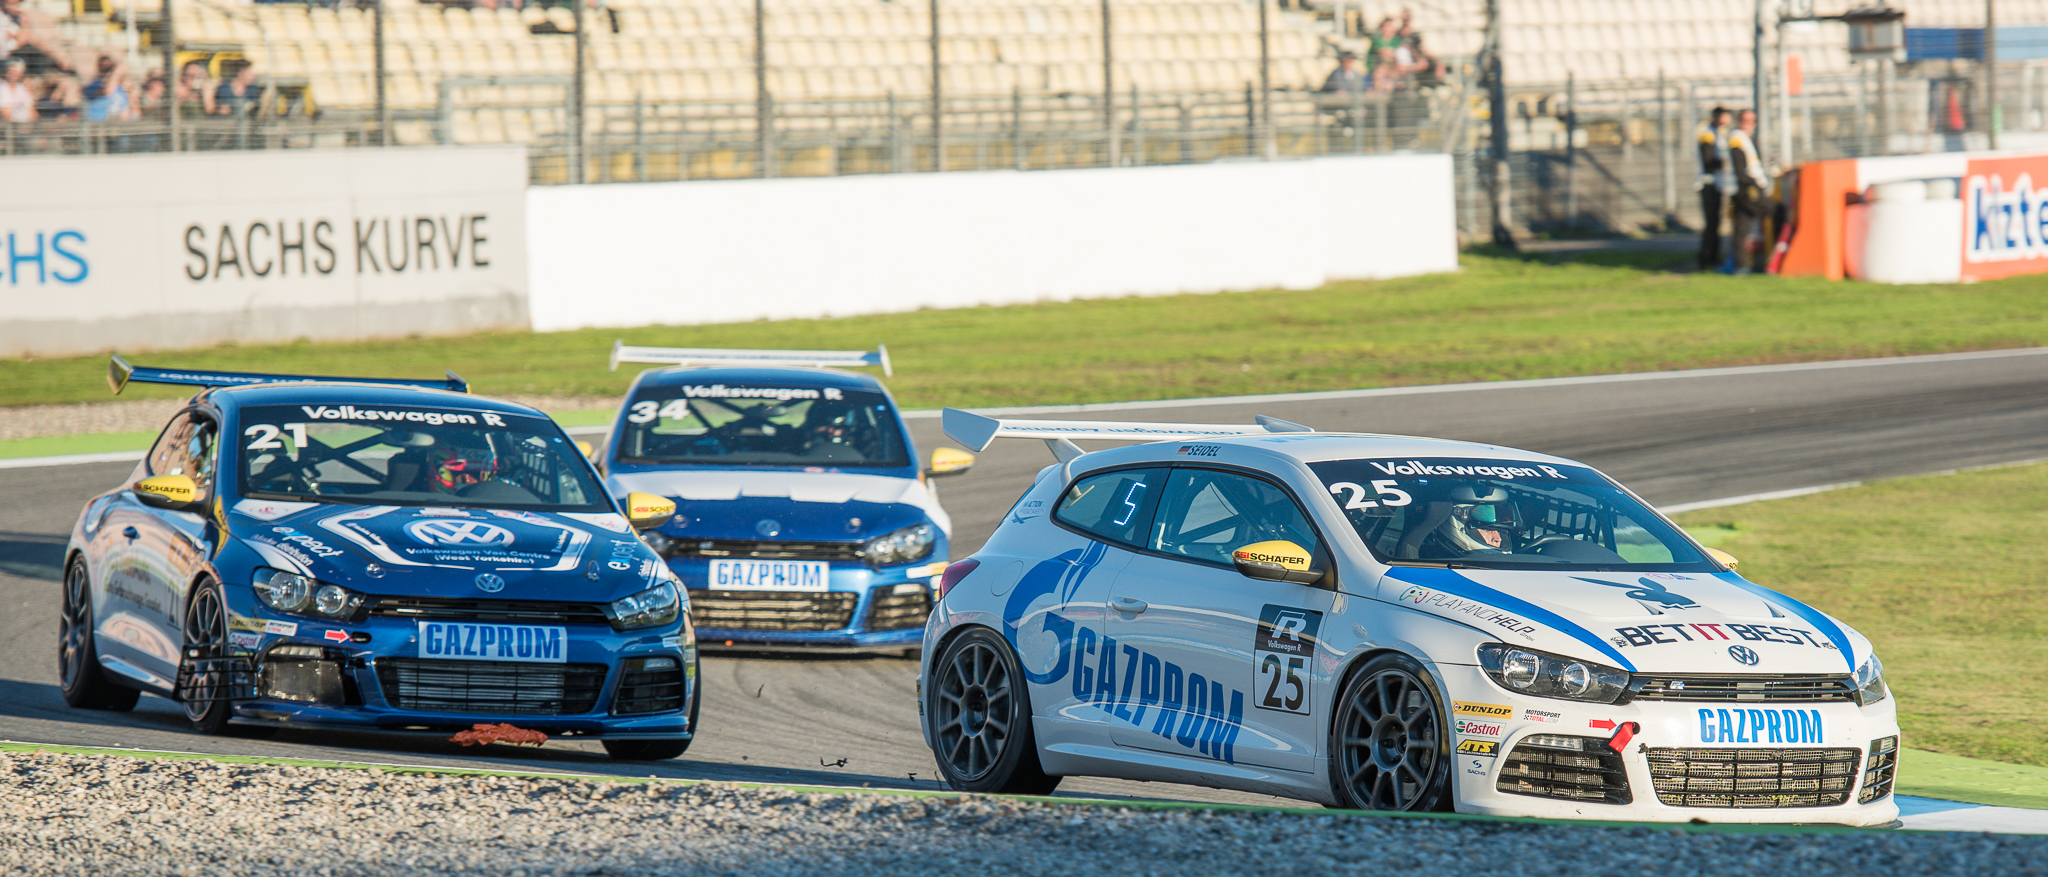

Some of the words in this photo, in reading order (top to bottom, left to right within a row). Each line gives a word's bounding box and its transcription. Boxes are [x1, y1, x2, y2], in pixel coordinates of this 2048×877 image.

[184, 220, 337, 281] SACHS
[354, 215, 492, 272] KURVE
[682, 384, 819, 401] Volkswagen
[823, 387, 844, 401] R
[301, 405, 477, 425] Volkswagen
[481, 413, 507, 427] R
[627, 399, 690, 423] 34
[244, 422, 308, 450] 21
[1187, 445, 1222, 457] SEIDEL
[1369, 460, 1541, 480] Volkswagen
[1538, 464, 1568, 480] R
[1329, 479, 1413, 510] 25
[405, 547, 481, 556] Volkswagen
[716, 562, 821, 588] GAZPROM
[425, 623, 561, 660] GAZPROM
[1267, 639, 1297, 652] Volkswagen
[1261, 653, 1304, 711] 25
[1072, 626, 1245, 765] GAZPROM
[1462, 704, 1512, 715] DUNLOP
[1525, 709, 1561, 719] MOTORSPORT
[1465, 722, 1501, 736] Castrol
[1698, 708, 1824, 745] GAZPROM
[1456, 740, 1496, 753] ATS
